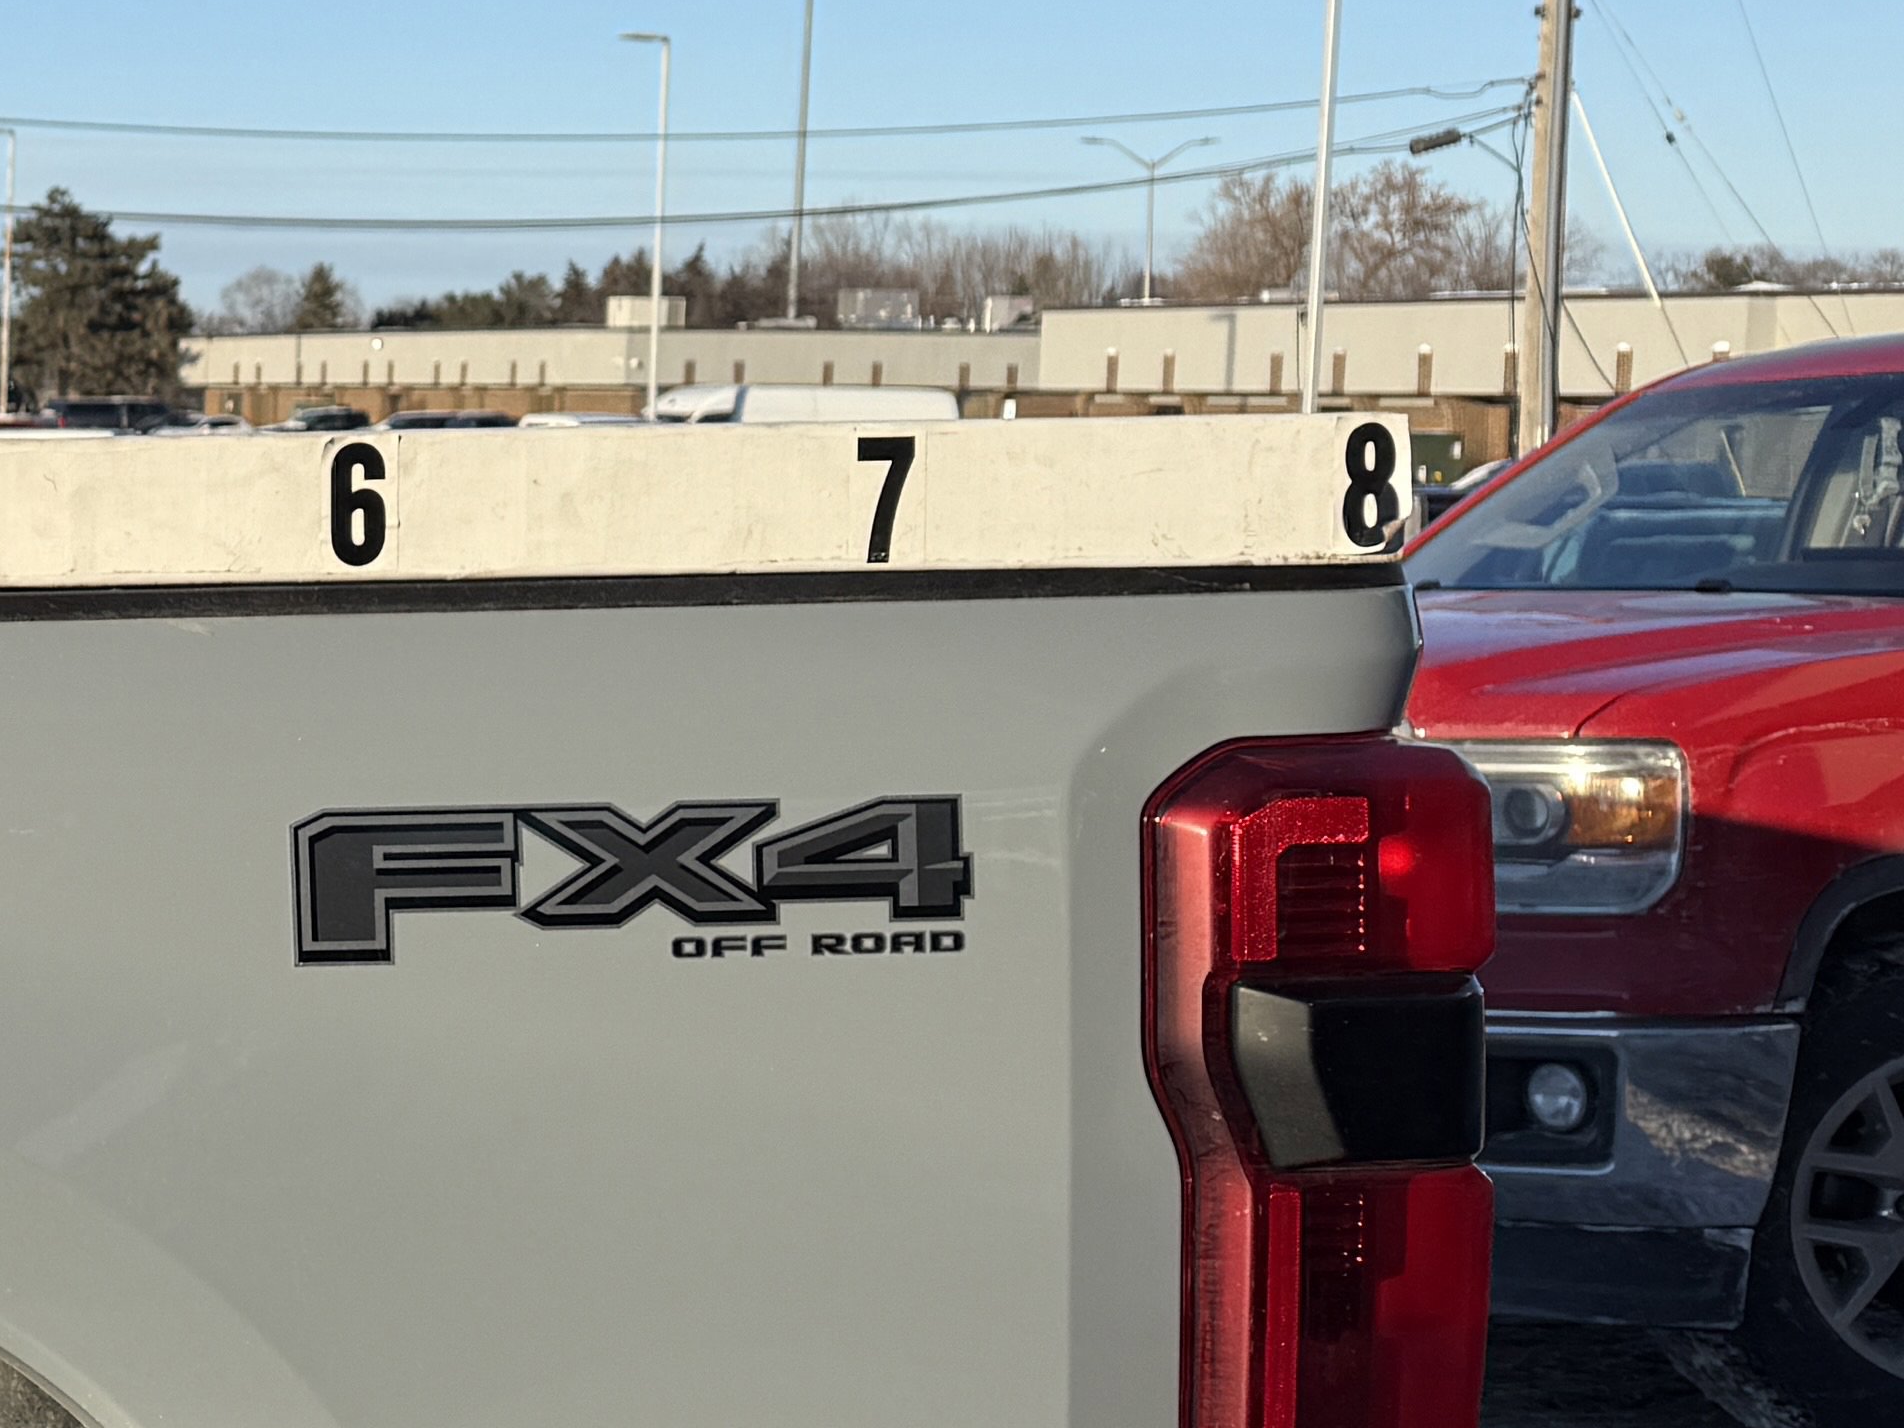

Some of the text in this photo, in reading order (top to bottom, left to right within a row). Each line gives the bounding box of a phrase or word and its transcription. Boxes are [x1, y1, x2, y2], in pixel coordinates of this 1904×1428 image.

[330, 442, 386, 567] 6
[857, 435, 916, 564] 7
[1342, 422, 1400, 548] 8
[290, 794, 975, 965] FX4
[671, 929, 967, 959] OFF ROAD
